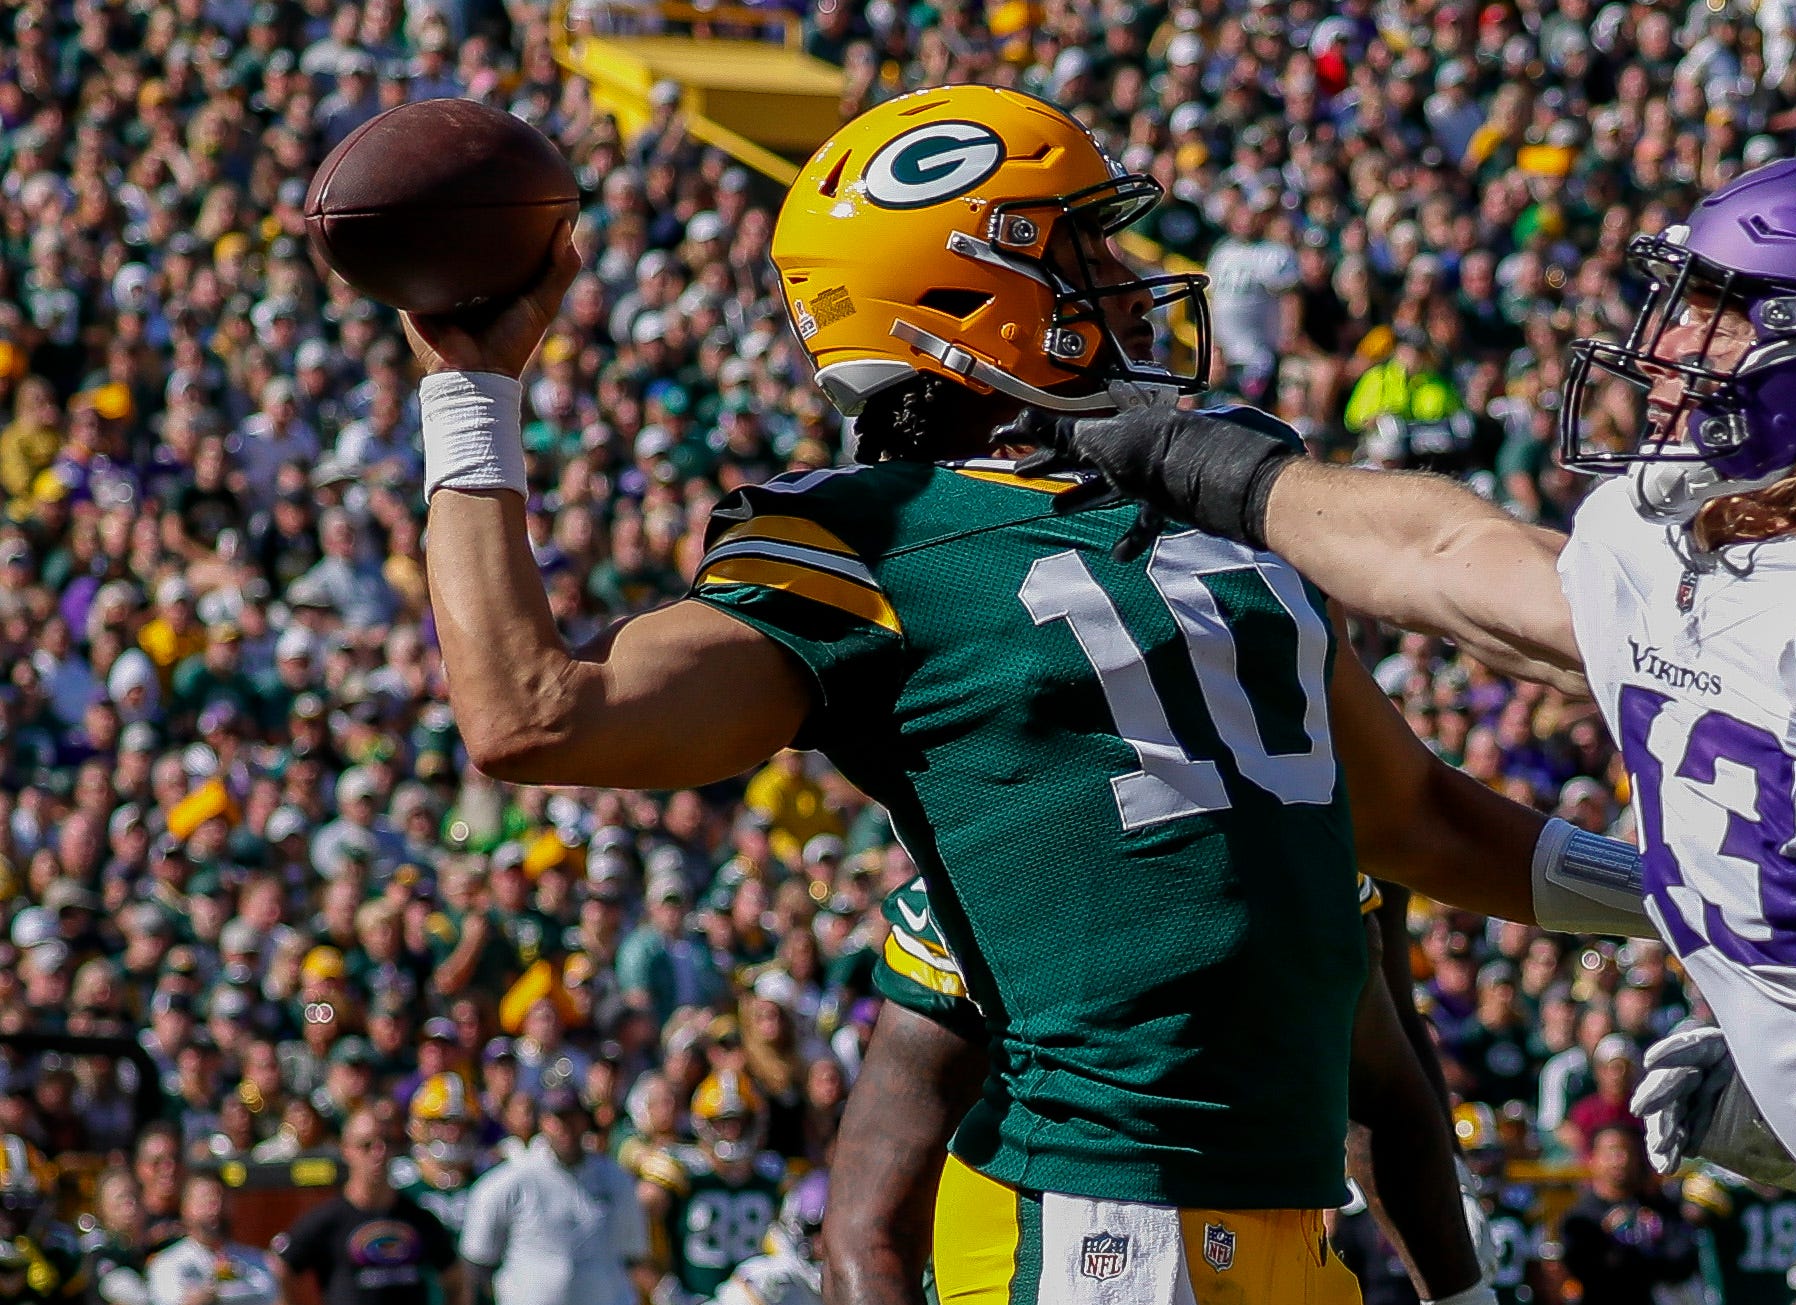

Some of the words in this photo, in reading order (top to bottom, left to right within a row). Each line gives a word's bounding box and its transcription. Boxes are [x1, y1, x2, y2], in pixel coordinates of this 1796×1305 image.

[866, 122, 999, 206] G
[1018, 529, 1335, 830] 10
[1087, 1254, 1121, 1277] NFL
[1208, 1243, 1231, 1264] NFL
